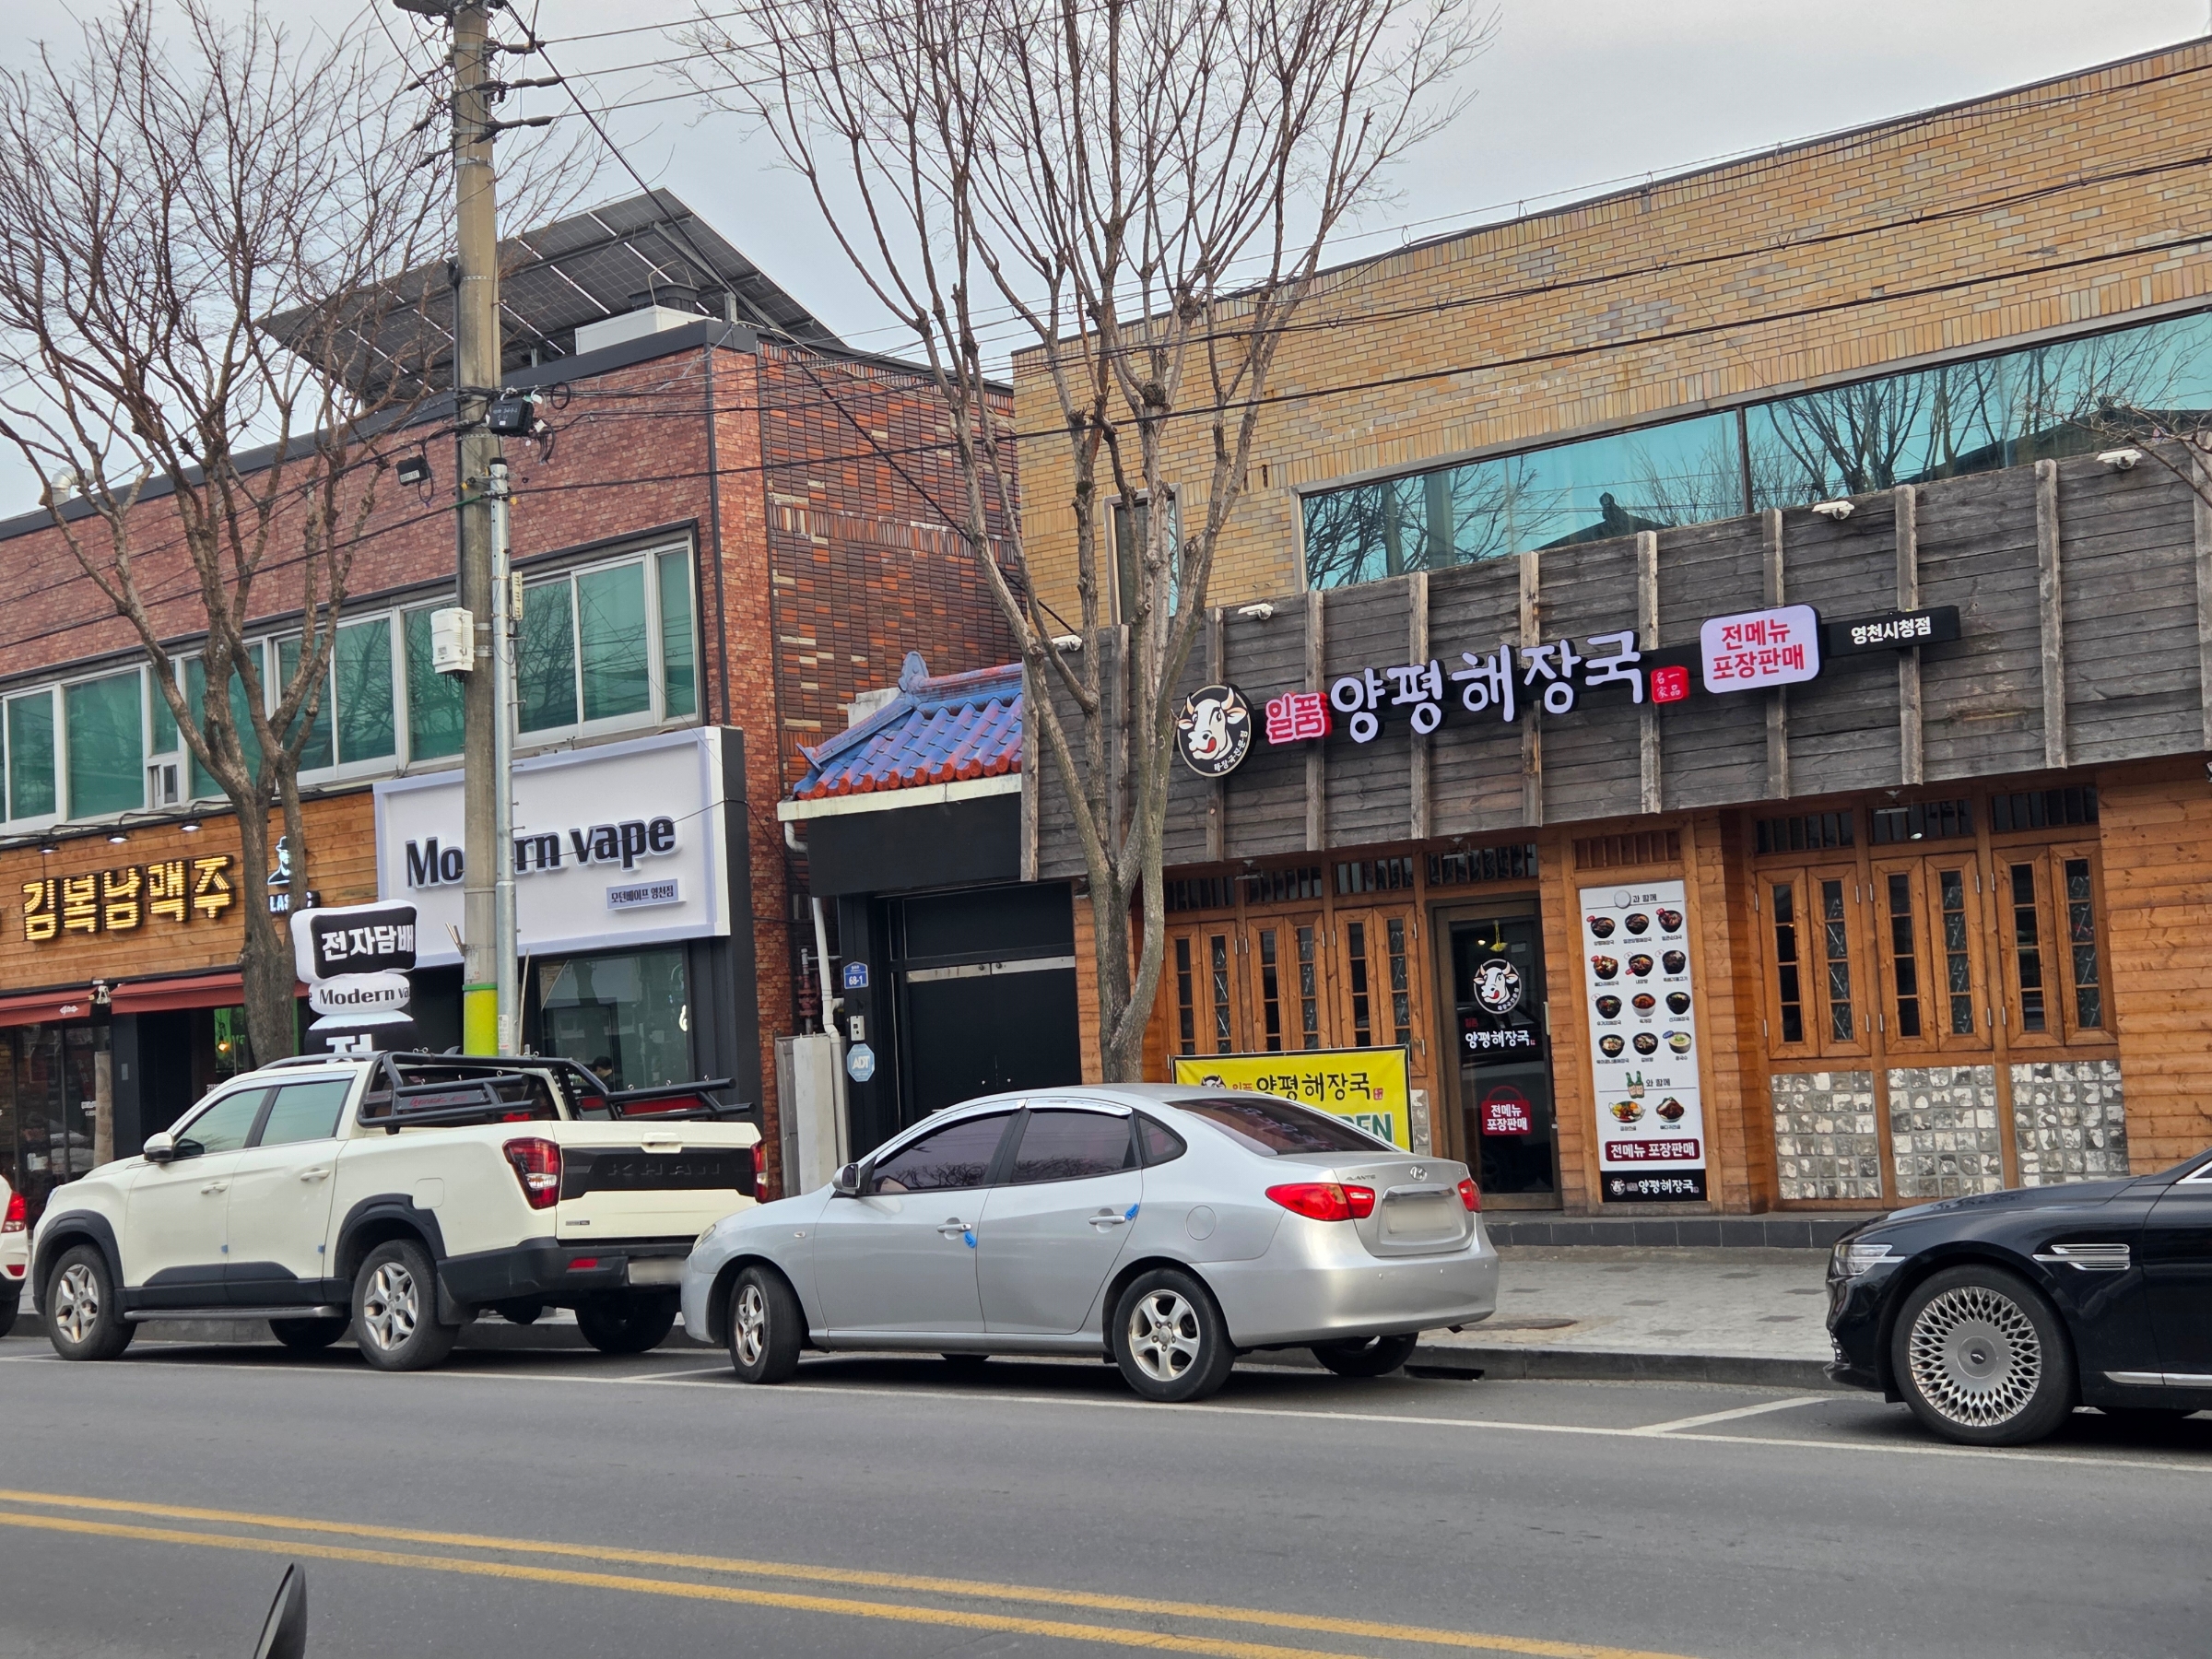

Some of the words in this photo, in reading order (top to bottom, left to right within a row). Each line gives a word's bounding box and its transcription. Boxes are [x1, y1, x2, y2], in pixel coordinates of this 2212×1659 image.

[1721, 618, 1791, 651] 전메뉴
[1852, 617, 1931, 644] 영천시청점
[1712, 644, 1805, 680] 포장판매
[1266, 692, 1325, 744] 일품
[1330, 630, 1644, 743] 양평해장국
[406, 833, 560, 887] Morn
[569, 817, 676, 871] vape
[22, 855, 232, 941] 김복남맥주
[611, 888, 649, 903] 모던베이프
[651, 885, 674, 900] 영천점
[321, 924, 414, 962] 전자담배
[849, 975, 863, 985] 68-1
[319, 988, 394, 1005] Modern
[398, 986, 410, 1001] va
[1465, 1030, 1530, 1049] 양평해장국
[852, 1055, 870, 1069] ADT
[1256, 1072, 1371, 1102] 양평해장국
[1490, 1104, 1522, 1117] 전메뉴
[1487, 1118, 1528, 1131] 포장판매
[1611, 1144, 1646, 1159] 전메뉴
[1648, 1142, 1695, 1158] 포장판매
[1639, 1179, 1694, 1194] 양평해장국
